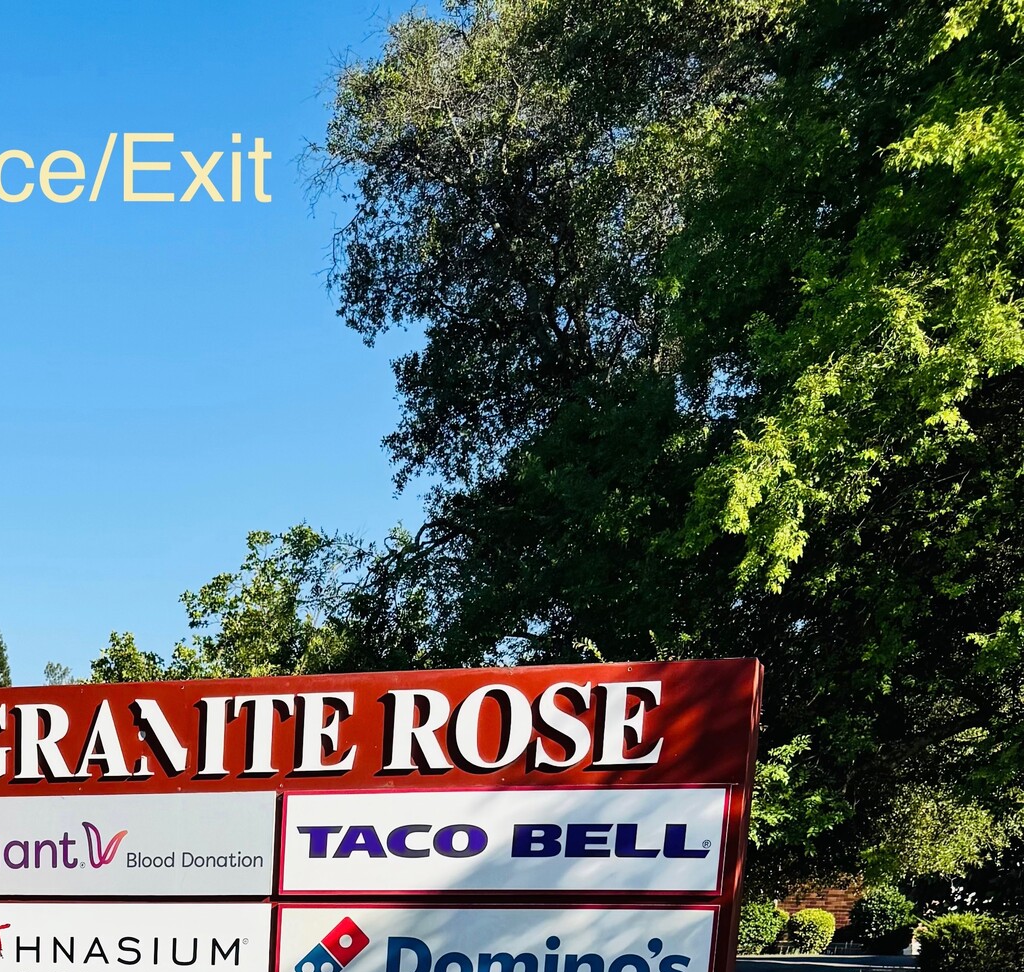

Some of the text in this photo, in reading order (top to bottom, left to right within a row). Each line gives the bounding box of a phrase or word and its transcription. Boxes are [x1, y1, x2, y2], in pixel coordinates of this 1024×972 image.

[376, 679, 666, 772] ROSE
[296, 823, 712, 859] TACO BELL
[126, 851, 264, 869] Blood Donation
